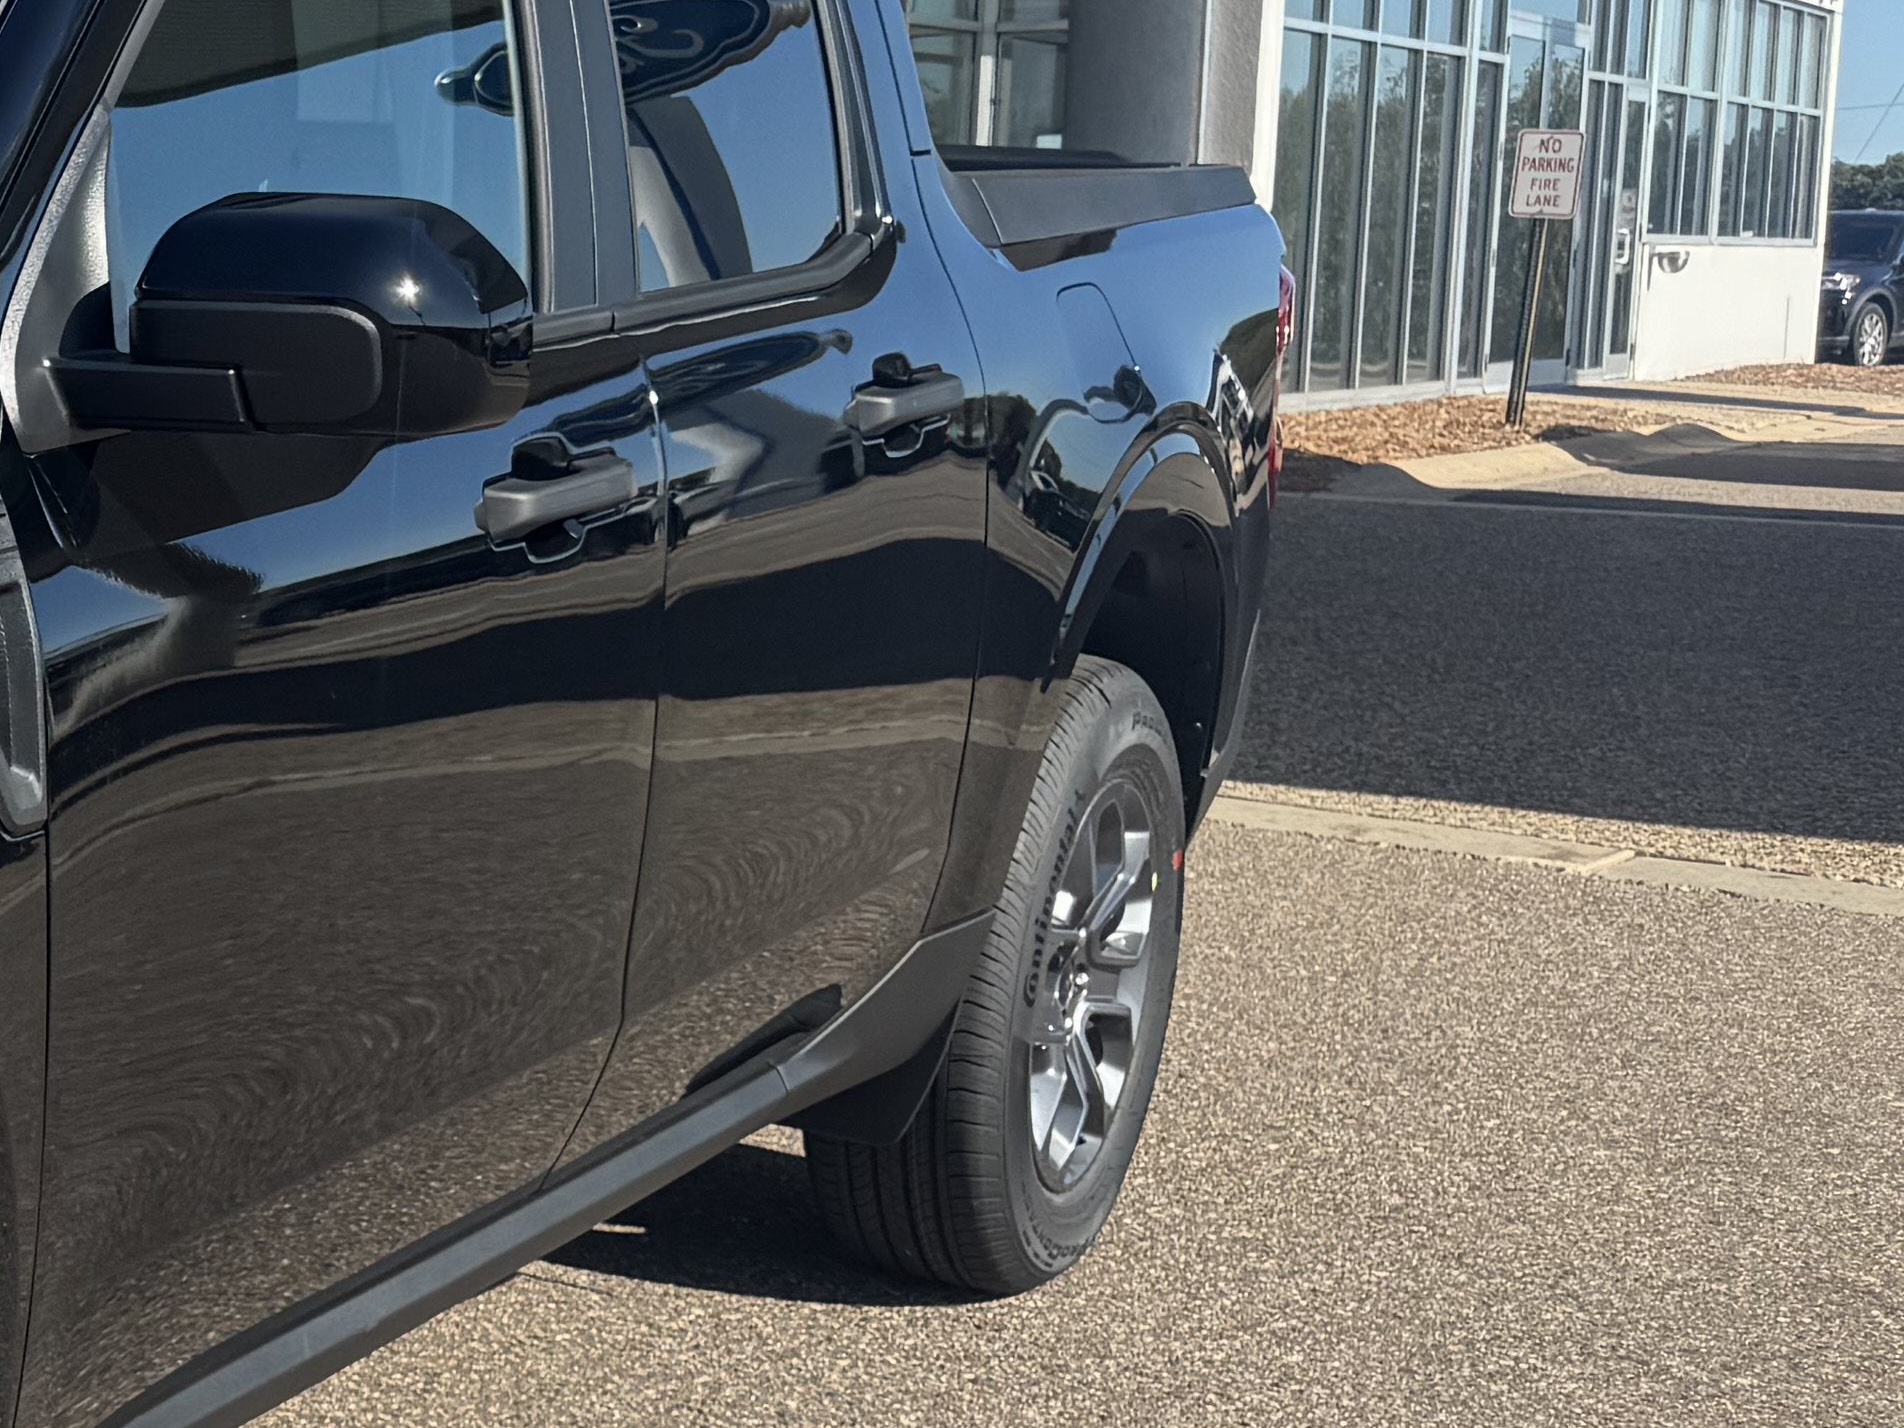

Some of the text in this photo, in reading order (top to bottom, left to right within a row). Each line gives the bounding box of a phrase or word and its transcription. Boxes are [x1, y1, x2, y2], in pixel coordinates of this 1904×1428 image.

[1538, 138, 1562, 154] NO
[1521, 156, 1575, 173] PARKING
[1530, 177, 1561, 191] FIRE
[1525, 194, 1560, 208] LANE
